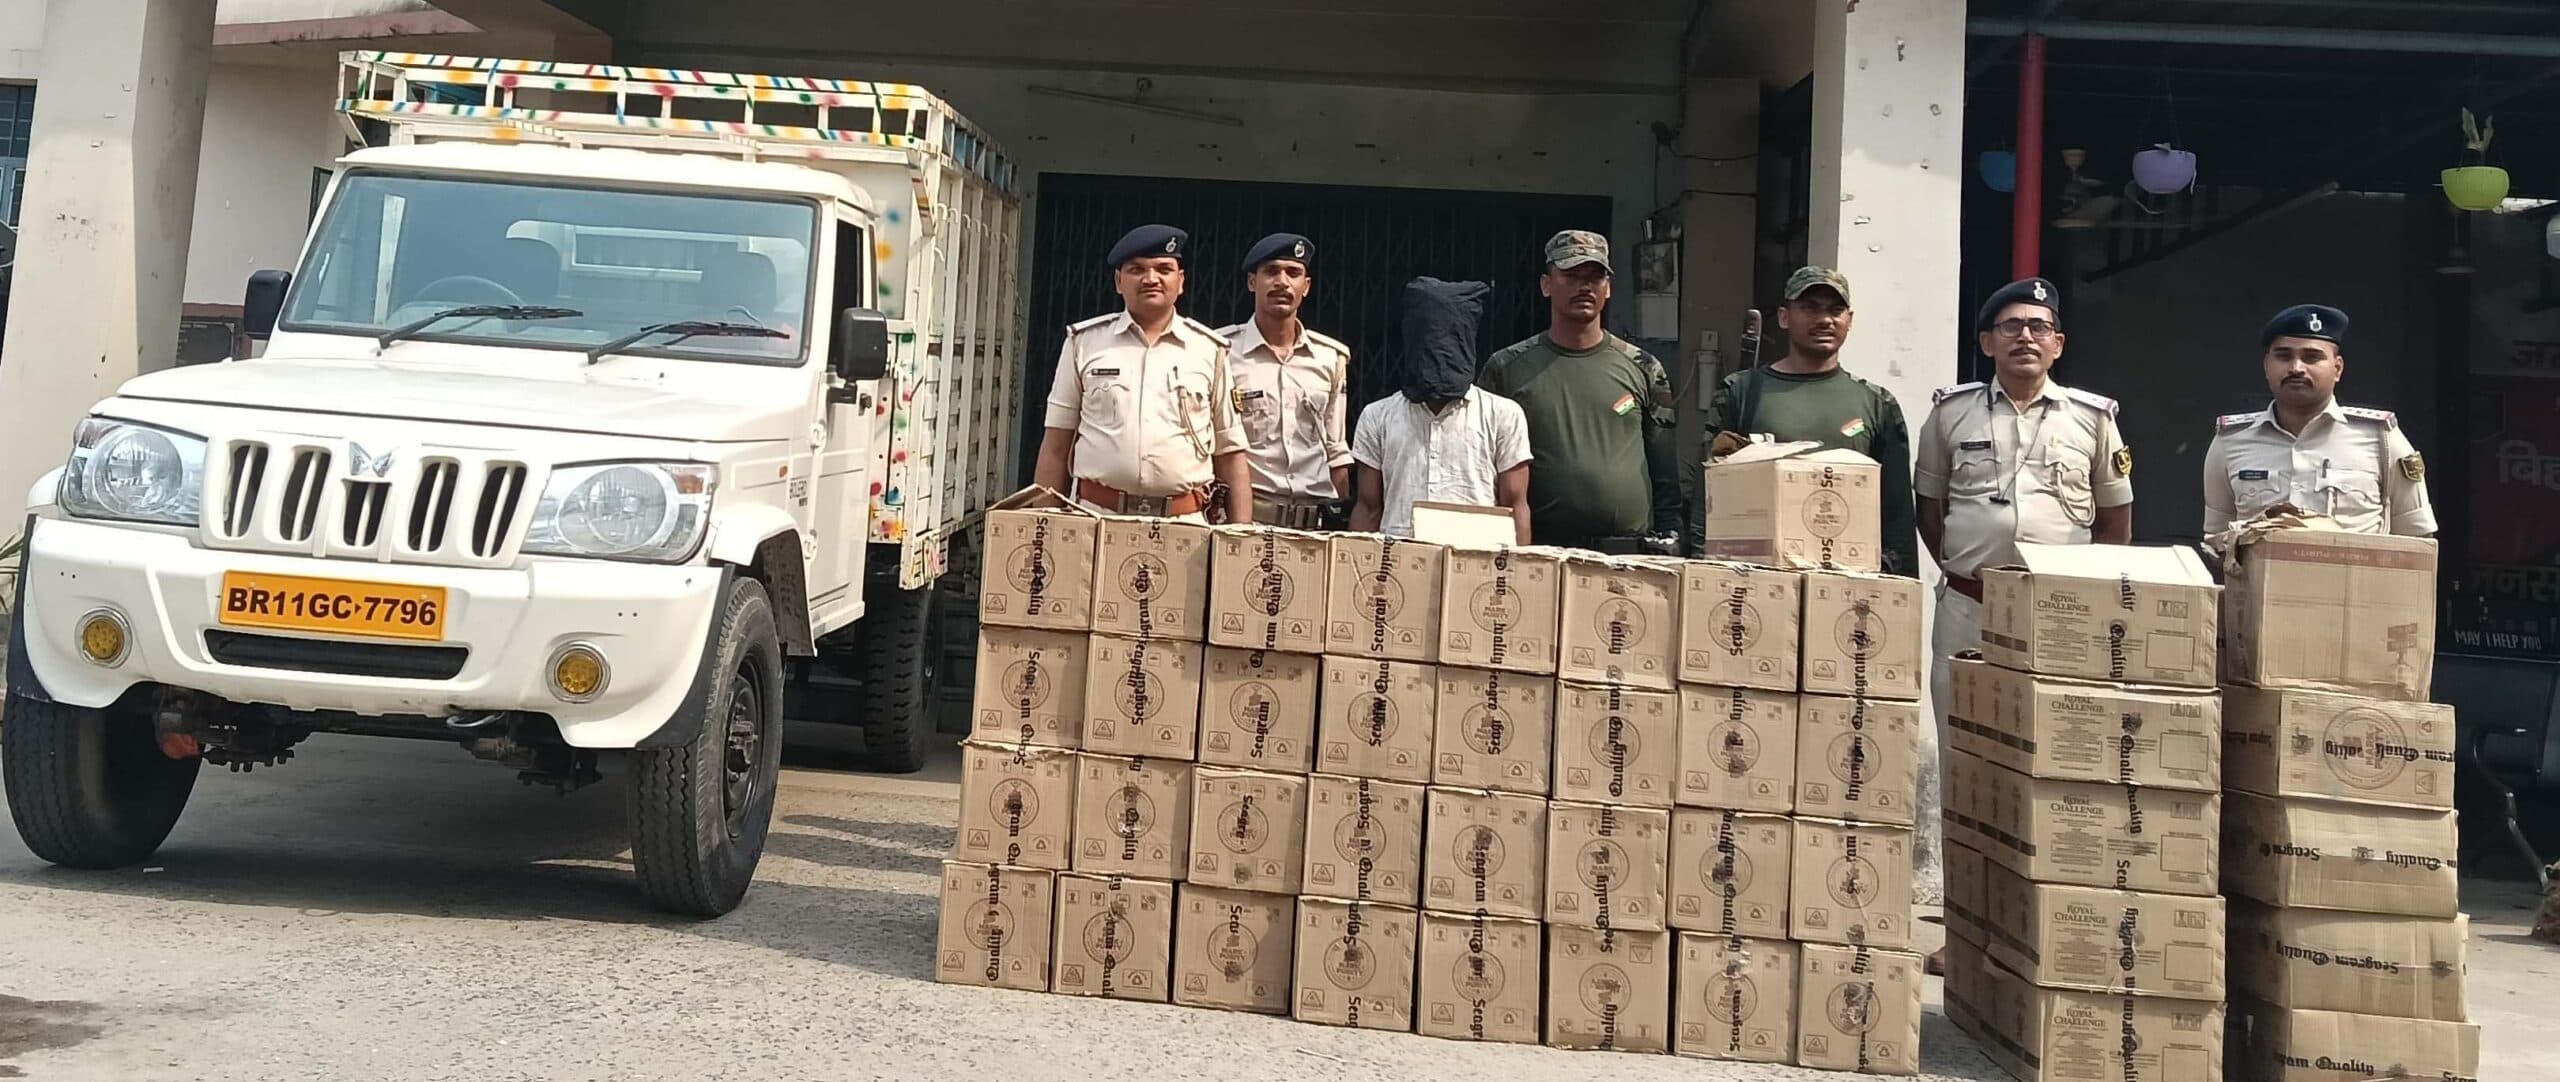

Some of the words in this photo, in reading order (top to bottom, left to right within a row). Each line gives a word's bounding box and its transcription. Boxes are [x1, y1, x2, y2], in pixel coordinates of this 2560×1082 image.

[227, 586, 353, 620] BR11GC
[364, 596, 437, 626] 7796
[2454, 630, 2481, 647] MAY
[1250, 701, 1270, 759] Seagram
[2385, 850, 2442, 872] Quality
[2054, 912, 2107, 925] CHALLENGE
[985, 927, 1004, 982] Quality
[2334, 953, 2400, 976] Seagram
[1730, 988, 1744, 1052] Seagram
[2314, 1055, 2376, 1077] Quality
